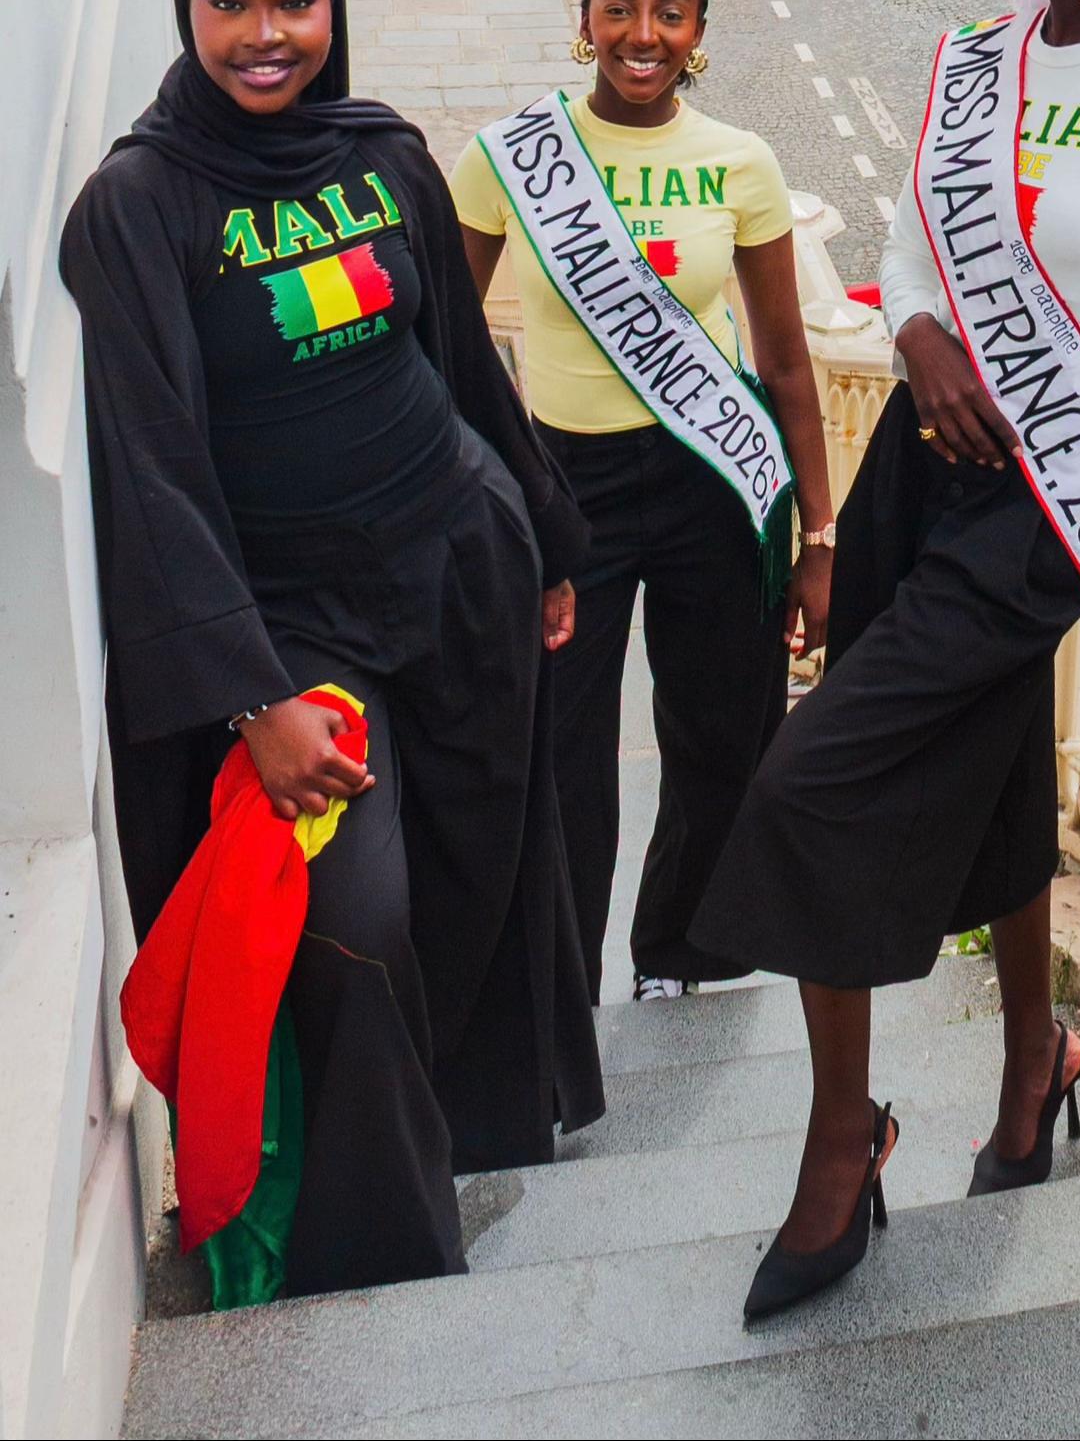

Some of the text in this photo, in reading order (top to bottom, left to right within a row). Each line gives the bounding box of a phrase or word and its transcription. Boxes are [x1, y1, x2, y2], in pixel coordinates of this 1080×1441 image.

[631, 219, 664, 237] BE
[293, 315, 390, 362] AFRICA
[698, 395, 777, 500] 2026
